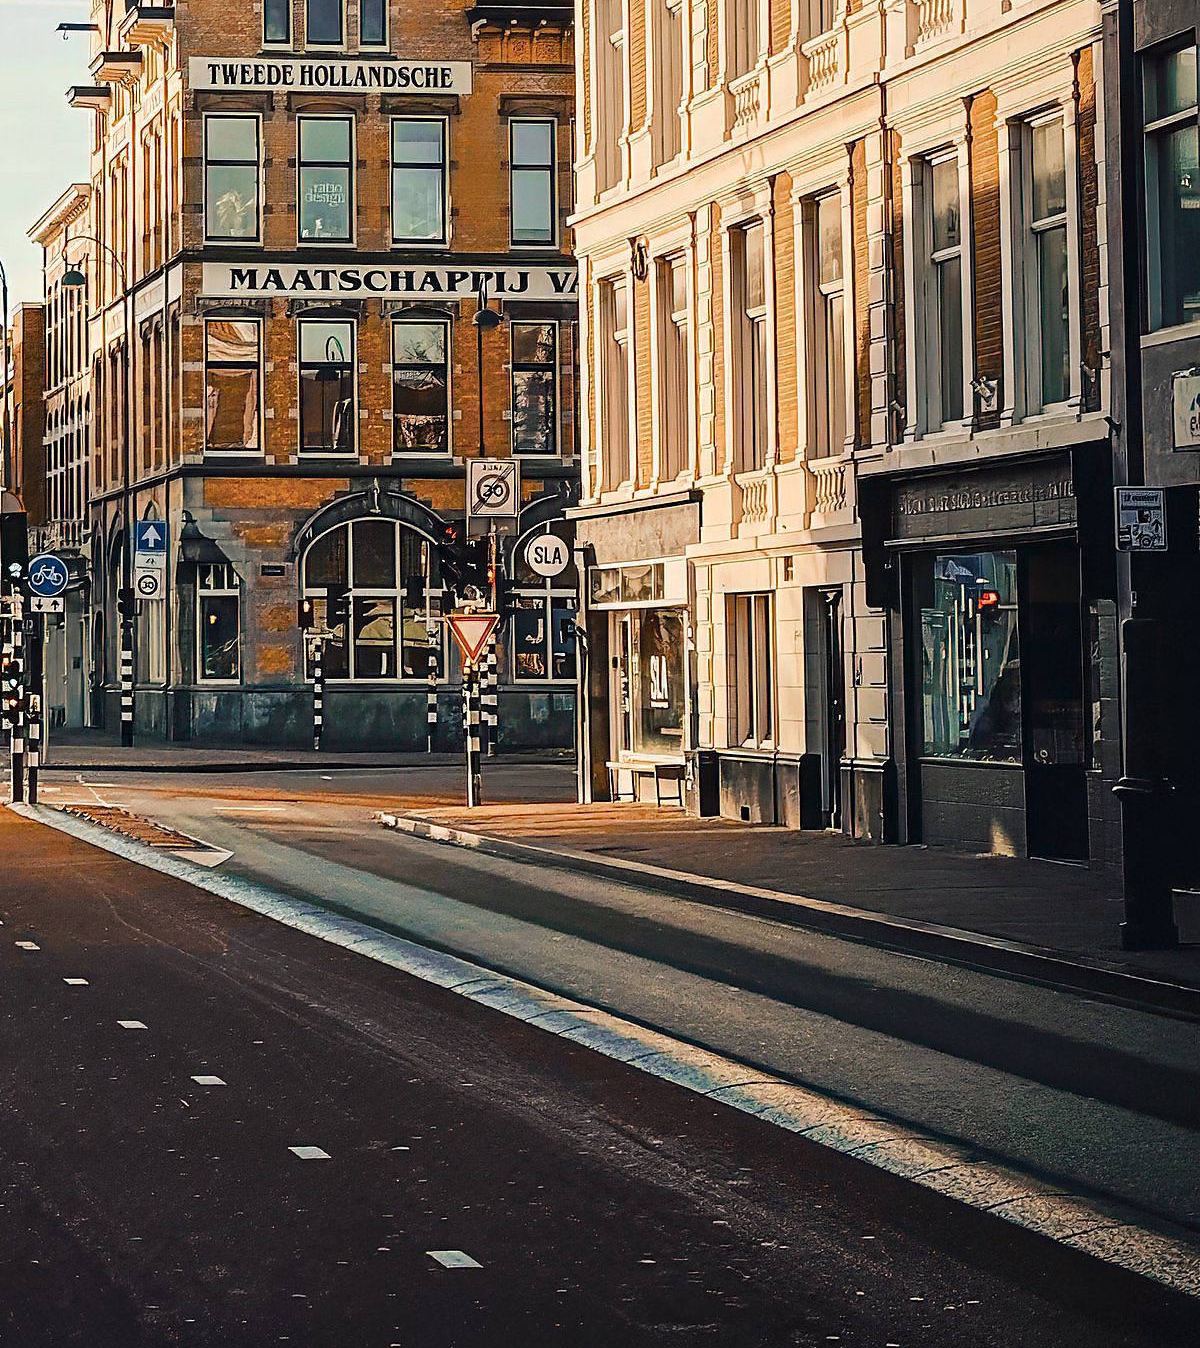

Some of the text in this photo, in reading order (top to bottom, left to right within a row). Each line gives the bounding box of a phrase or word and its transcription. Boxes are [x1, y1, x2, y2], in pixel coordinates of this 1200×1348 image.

[207, 63, 453, 89] TWEEDE HOLLANDSCHE
[229, 268, 530, 294] MAATSCHAPPIJ
[533, 546, 563, 565] SLA
[650, 655, 669, 701] SLA
